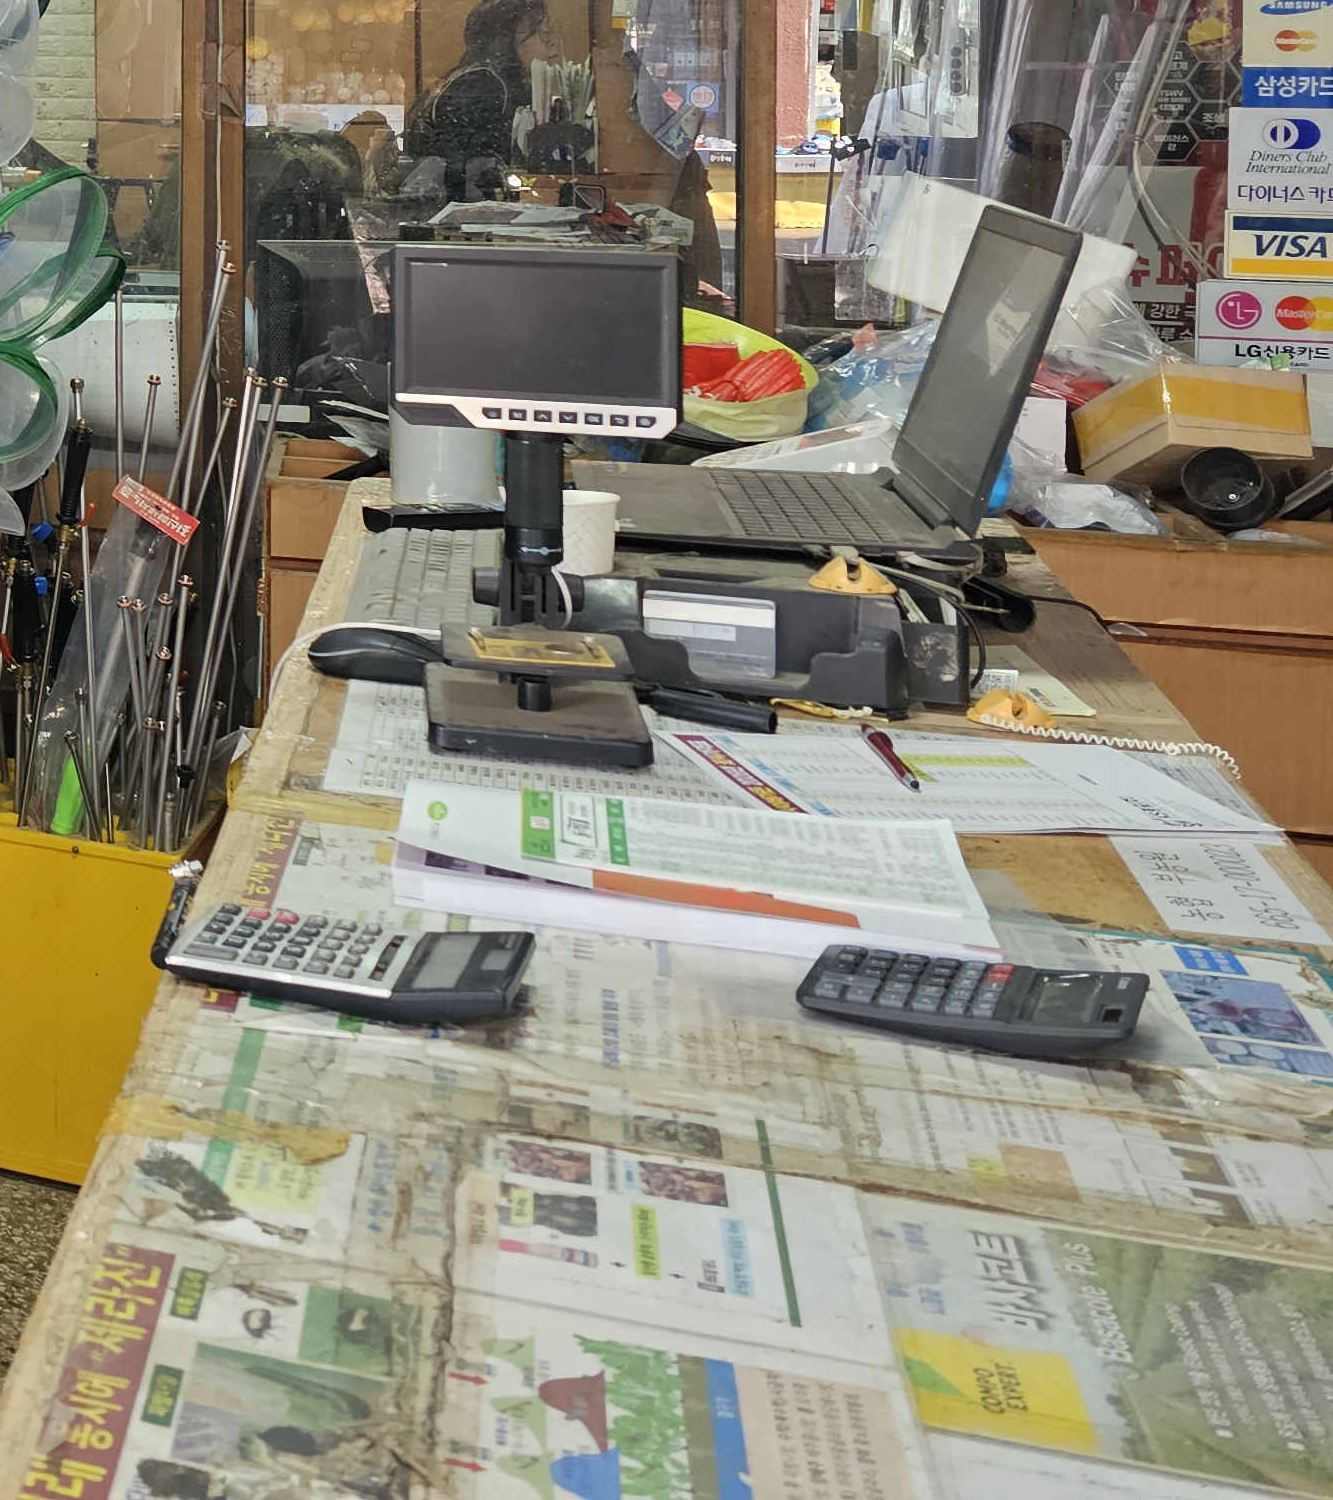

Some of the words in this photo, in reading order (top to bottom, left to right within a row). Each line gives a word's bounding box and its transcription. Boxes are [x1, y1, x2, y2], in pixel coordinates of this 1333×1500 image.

[1250, 150, 1293, 163] Diners
[1296, 150, 1327, 163] Club
[1245, 162, 1332, 174] International
[1253, 234, 1328, 258] VISA
[1235, 344, 1329, 360] LG신용카드
[973, 1367, 1006, 1416] COMPO
[999, 1360, 1028, 1412] EXPERT
